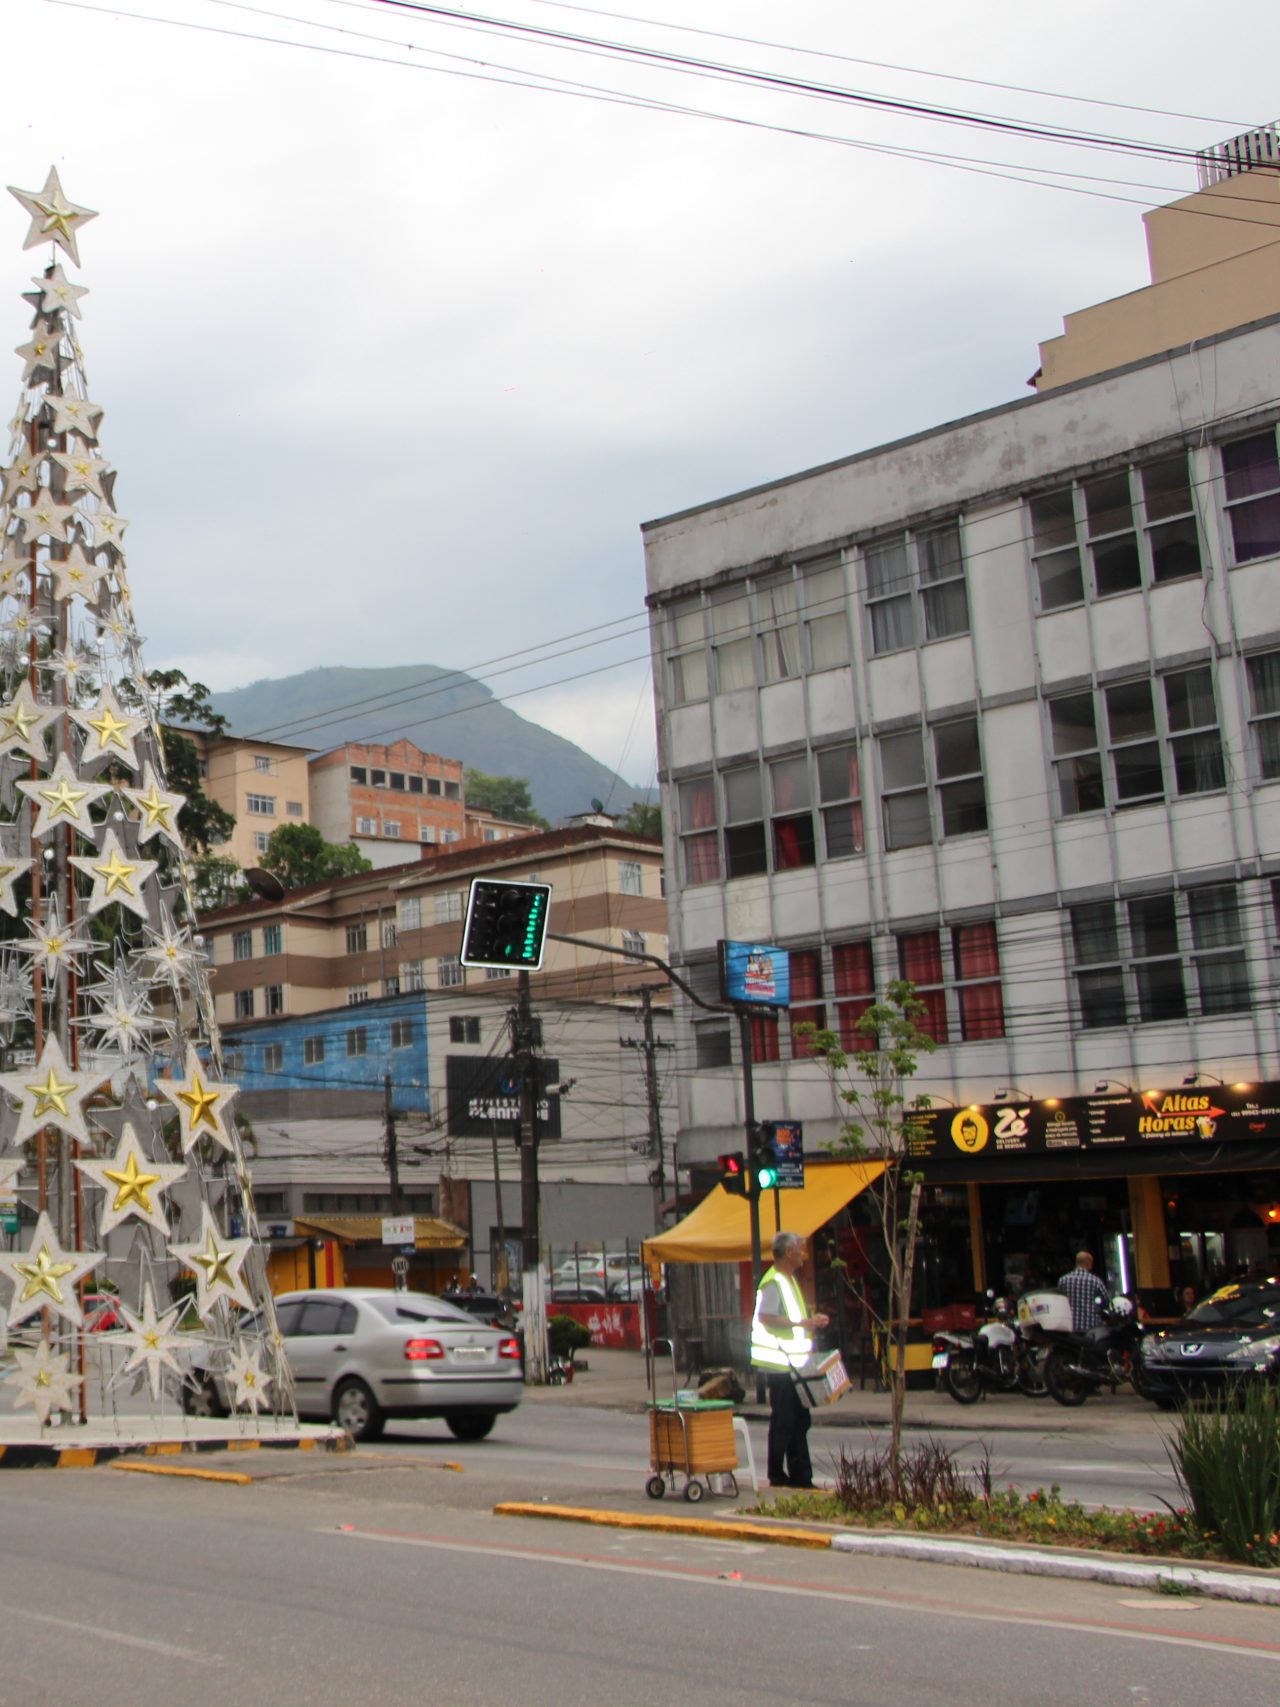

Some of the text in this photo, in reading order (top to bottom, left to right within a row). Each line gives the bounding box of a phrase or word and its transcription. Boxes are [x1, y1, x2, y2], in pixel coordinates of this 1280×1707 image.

[1162, 1094, 1209, 1113] Altas
[994, 1108, 1030, 1138] Zé
[1139, 1116, 1195, 1133] Horas
